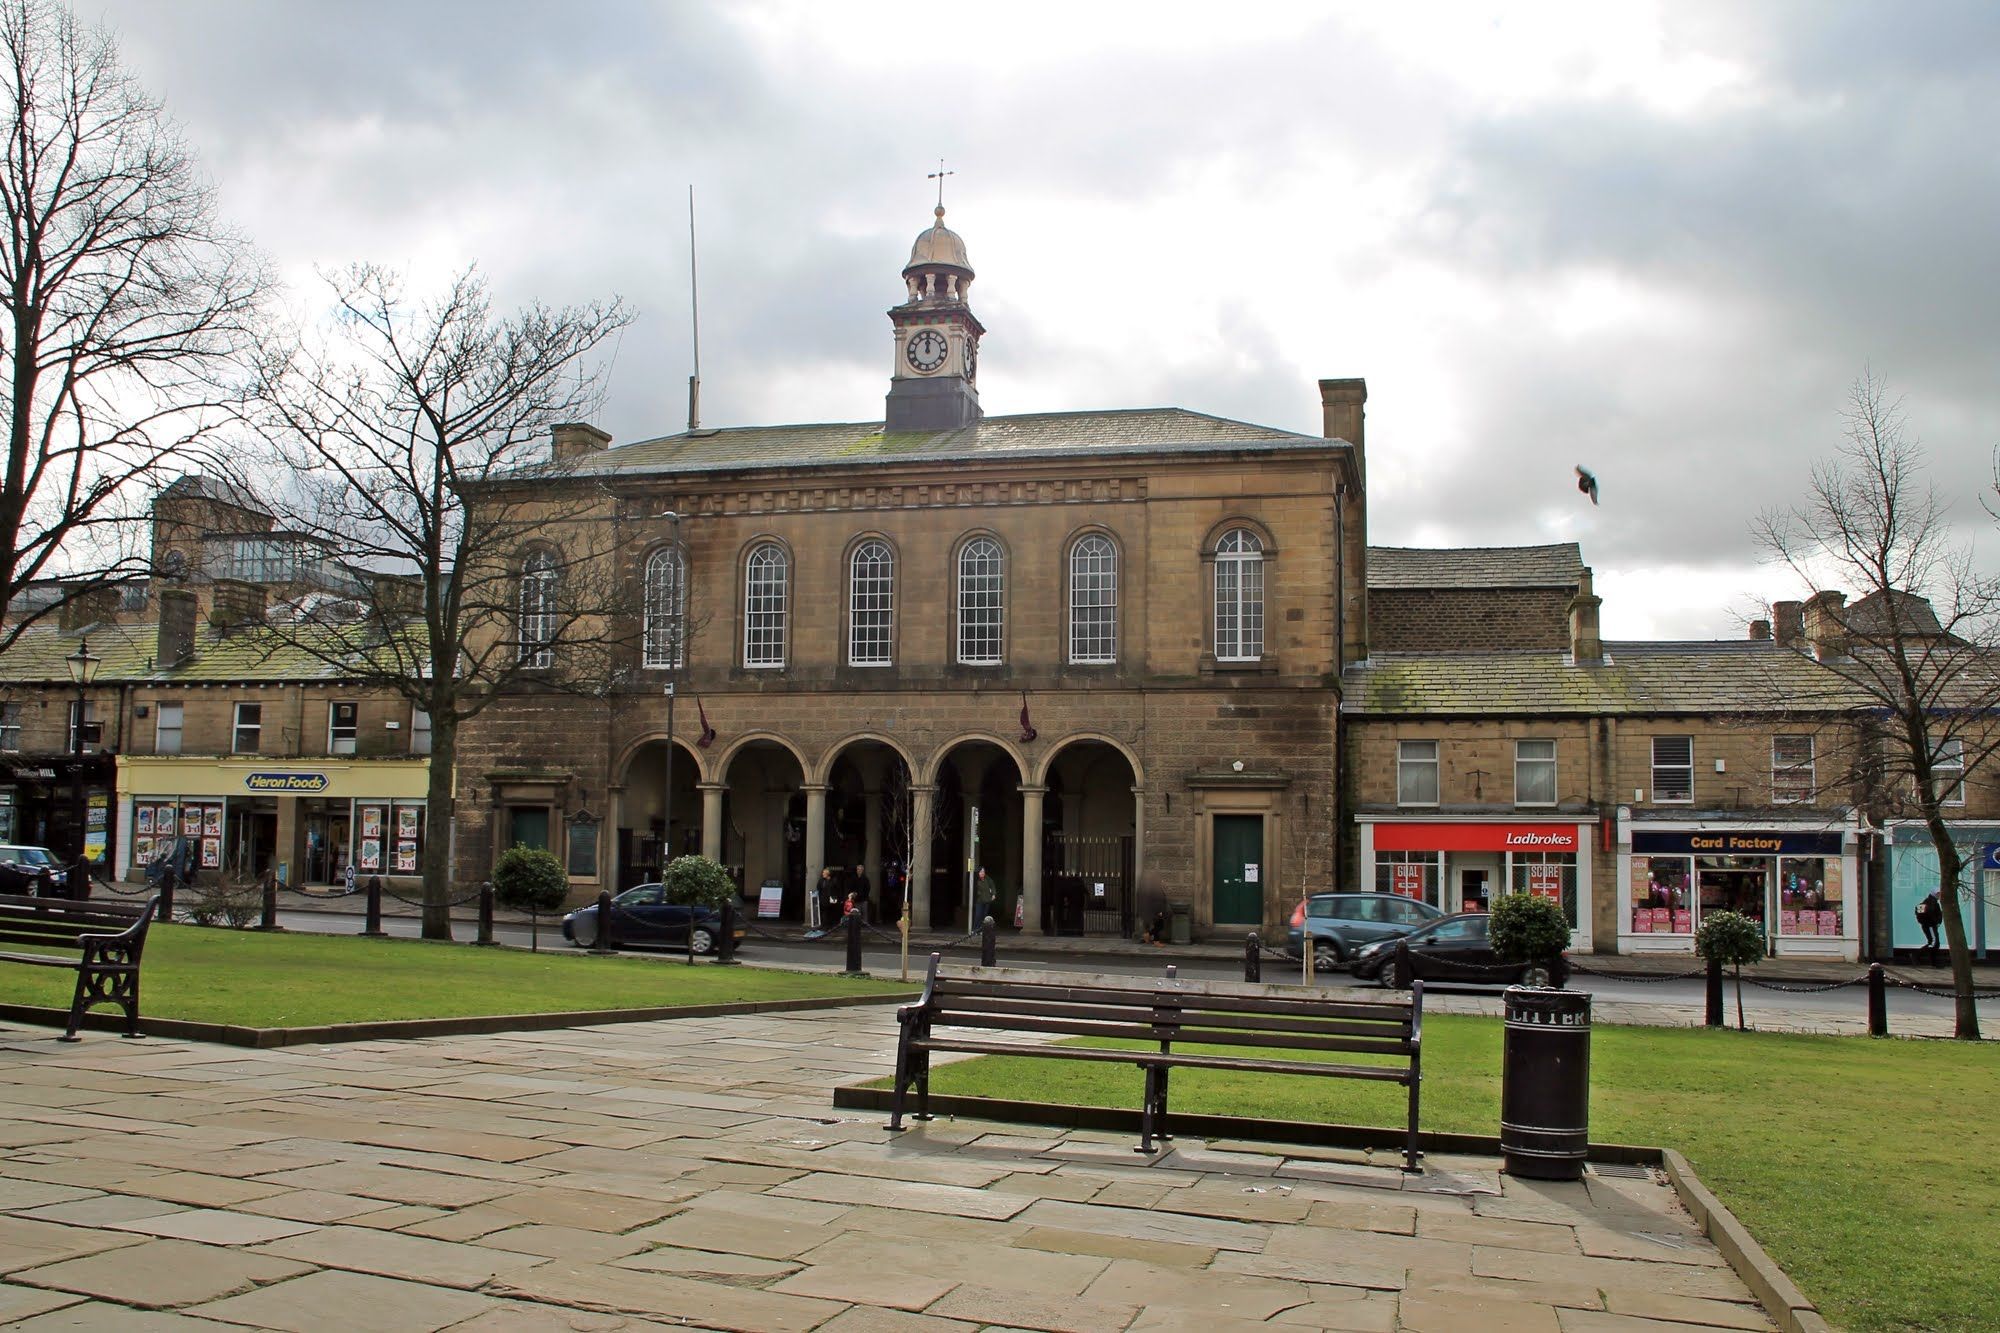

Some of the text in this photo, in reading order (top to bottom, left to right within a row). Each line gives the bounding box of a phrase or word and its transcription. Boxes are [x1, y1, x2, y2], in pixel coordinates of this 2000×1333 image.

[39, 768, 56, 777] HILL
[249, 775, 323, 788] Heron Foods
[1506, 832, 1572, 845] Ladbrokes
[1690, 837, 1783, 851] Card Factory
